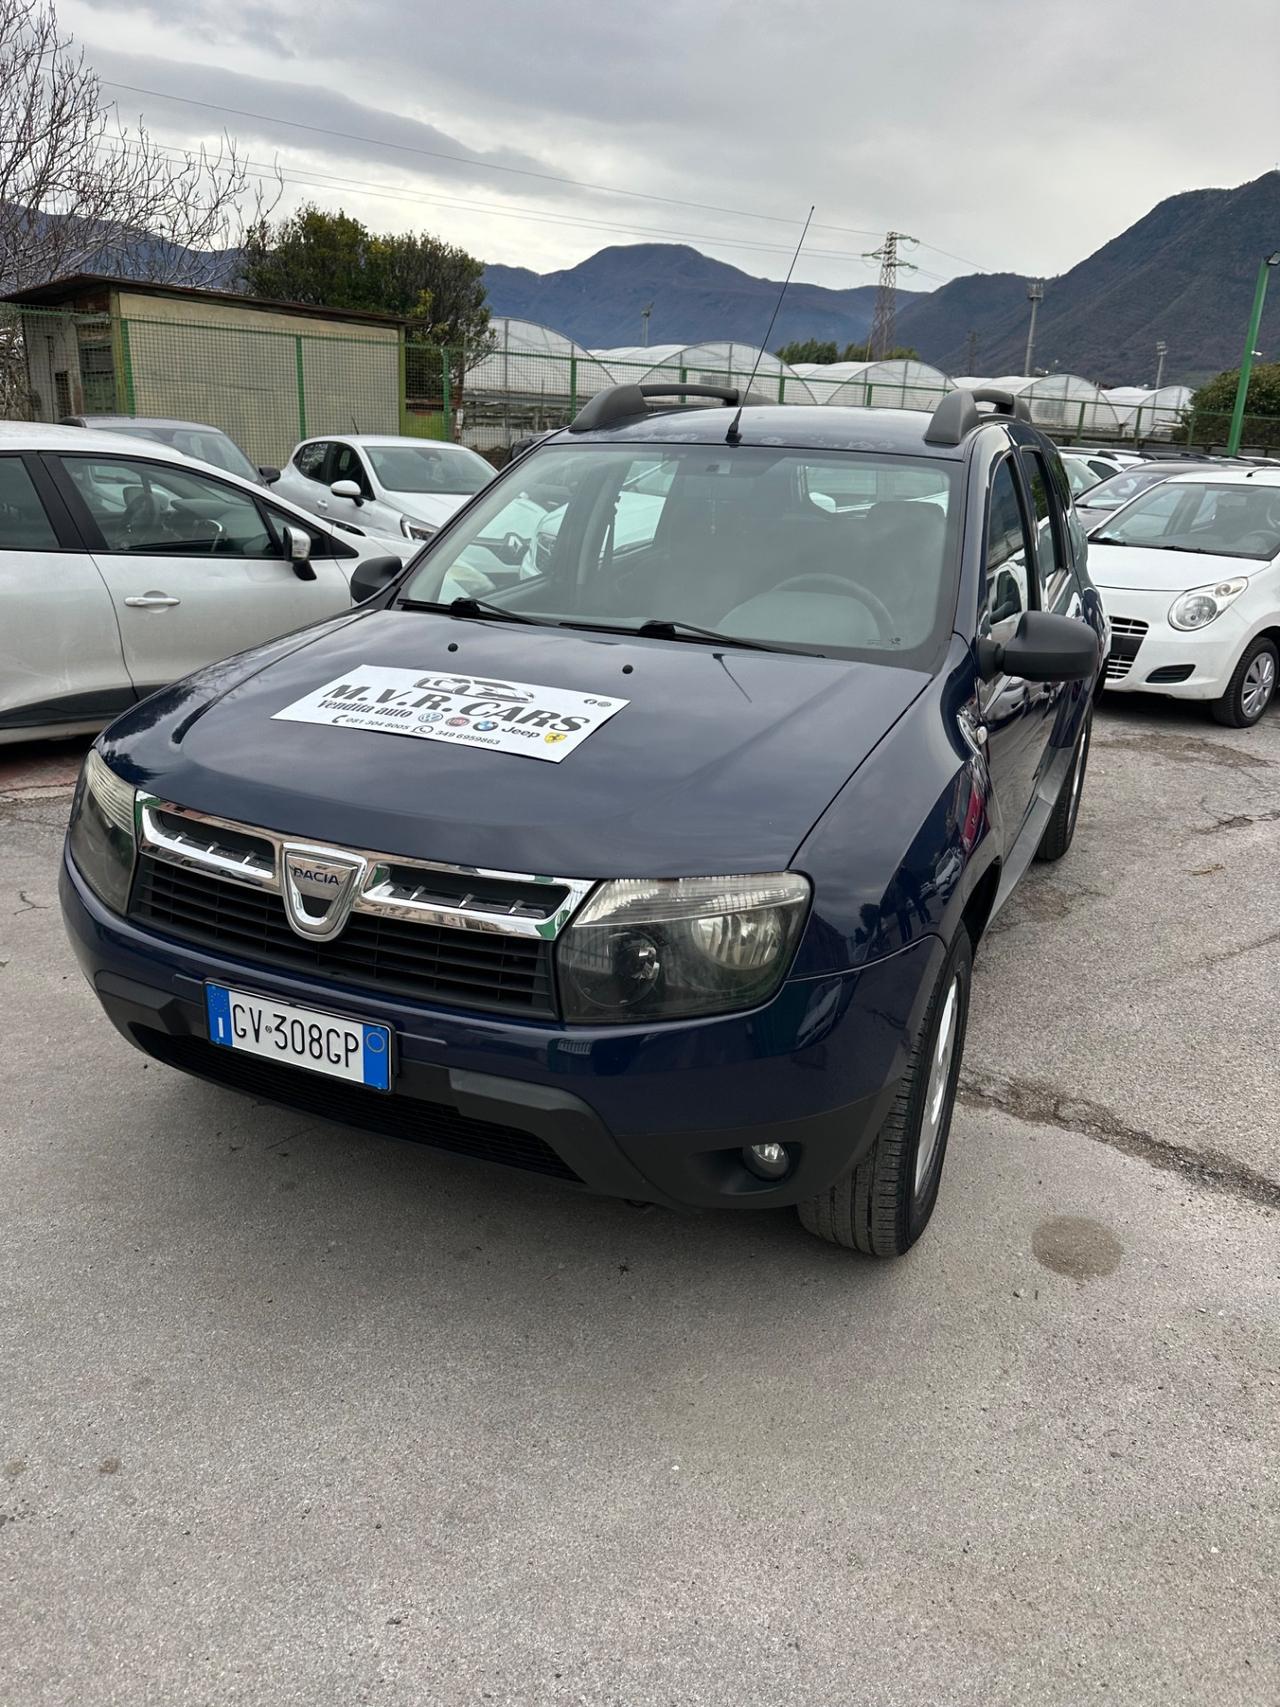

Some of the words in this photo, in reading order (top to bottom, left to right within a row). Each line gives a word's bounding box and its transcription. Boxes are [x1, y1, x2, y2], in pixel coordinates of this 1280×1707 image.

[317, 700, 375, 713] Vendita
[374, 707, 413, 718] auto
[501, 726, 541, 739] Jeep
[293, 867, 340, 886] DACIA
